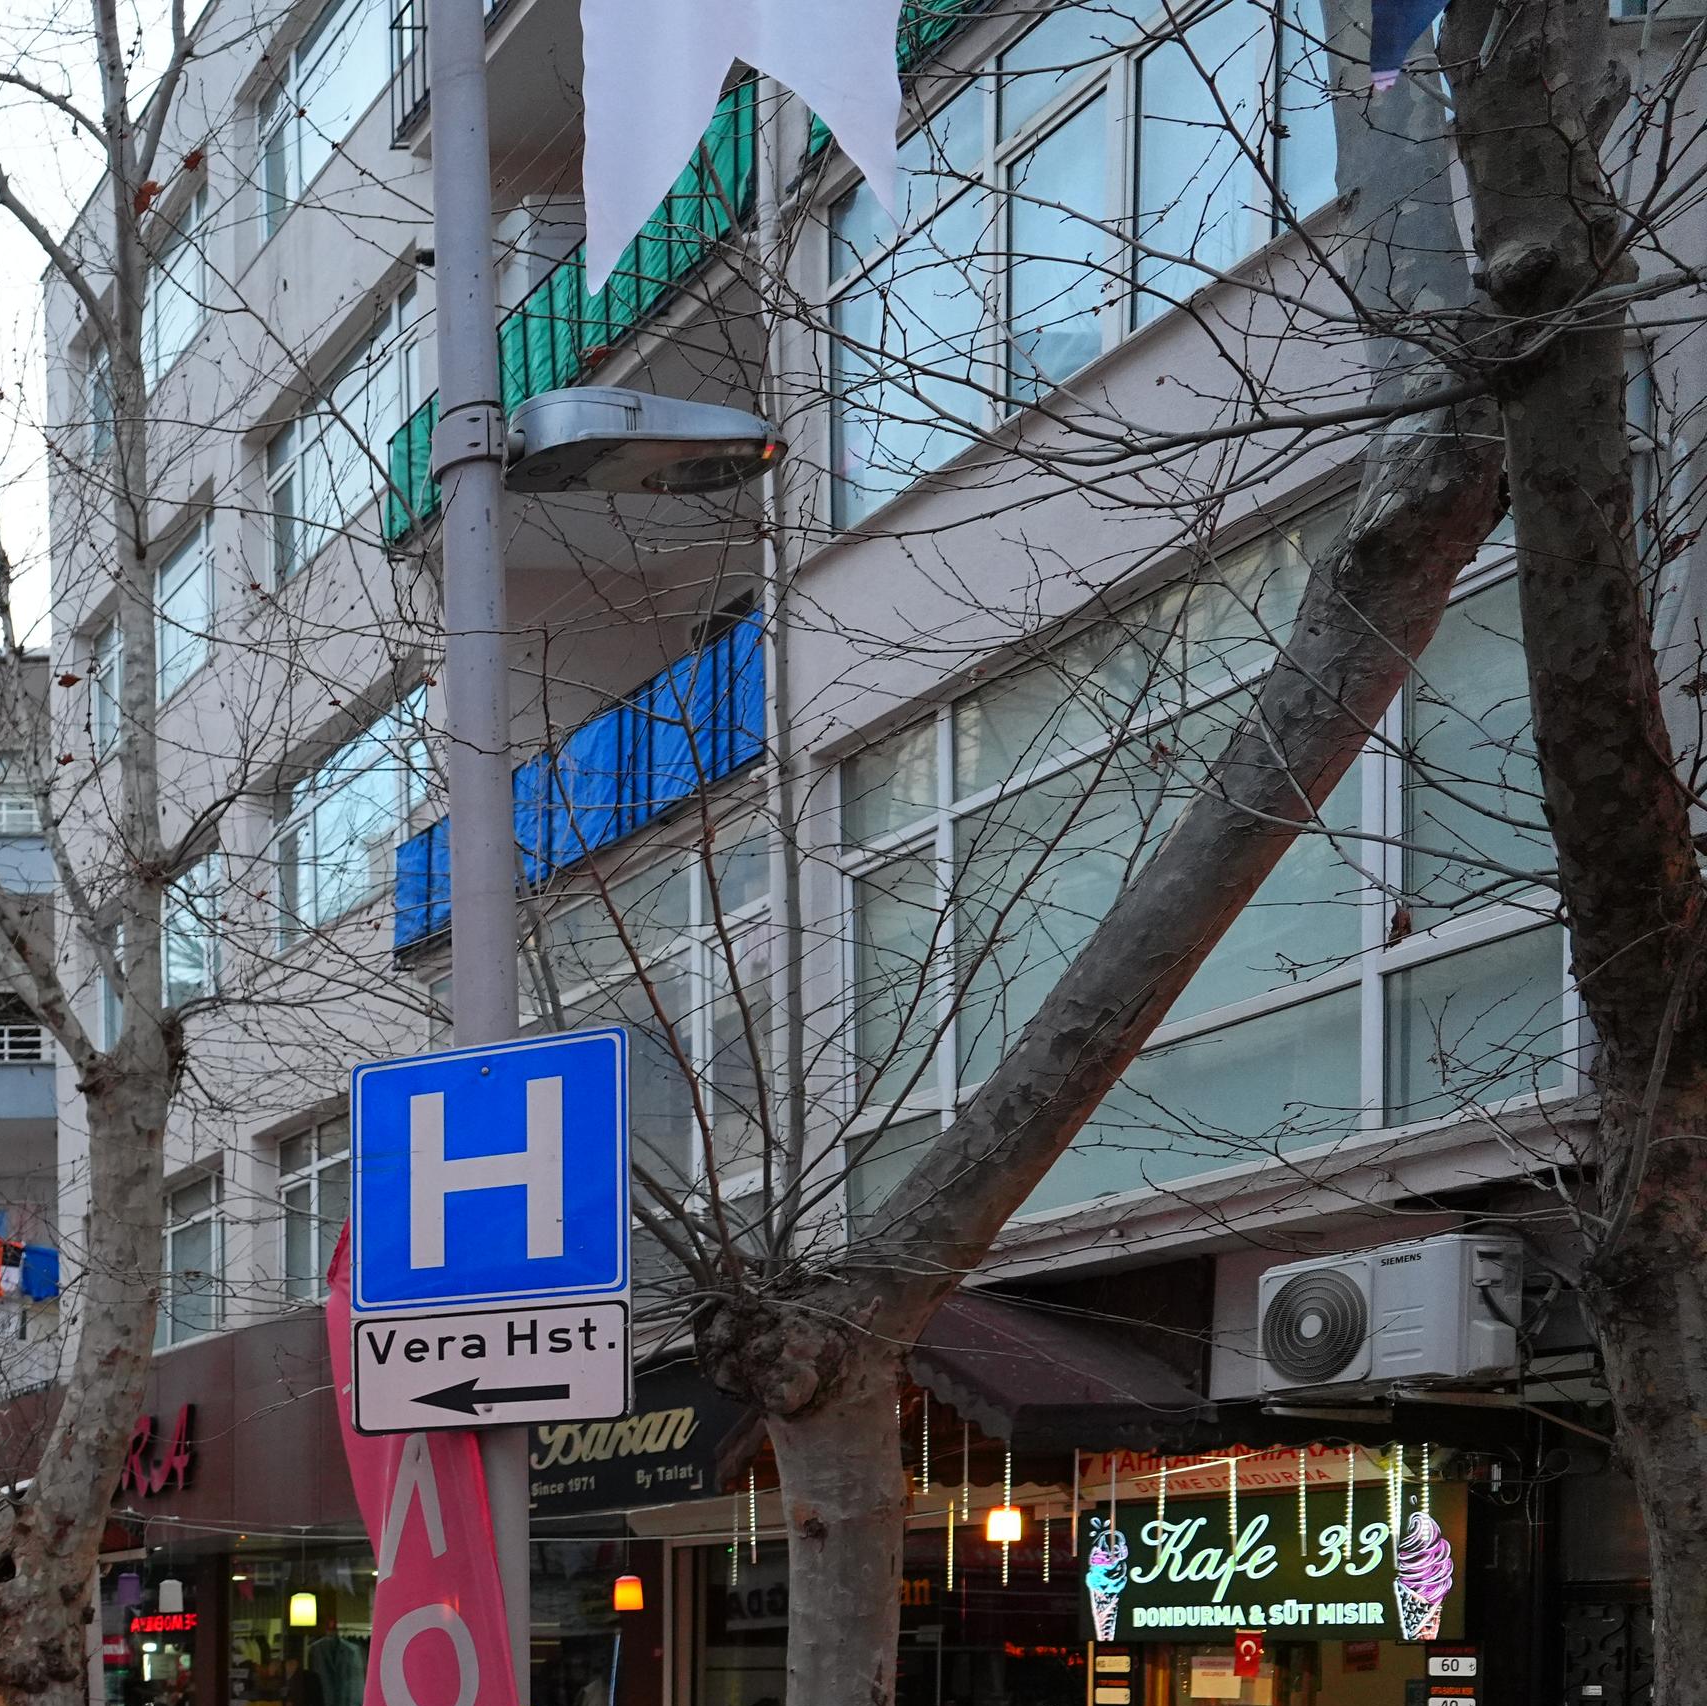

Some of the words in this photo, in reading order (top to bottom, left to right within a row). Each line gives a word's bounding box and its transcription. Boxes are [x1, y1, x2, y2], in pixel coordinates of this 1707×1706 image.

[409, 1076, 565, 1270] H
[366, 1329, 487, 1365] Vera
[507, 1317, 618, 1356] Hst.
[530, 1479, 564, 1496] Since
[567, 1475, 596, 1492] 1971
[636, 1469, 652, 1489] By
[656, 1463, 694, 1482] Talat
[1129, 1513, 1279, 1603] Kafe
[1305, 1522, 1389, 1578] 33
[1132, 1606, 1247, 1627] DONDURMA
[1268, 1600, 1314, 1625] SÜT
[1317, 1602, 1385, 1625] MISIR
[1441, 1658, 1460, 1672] 60
